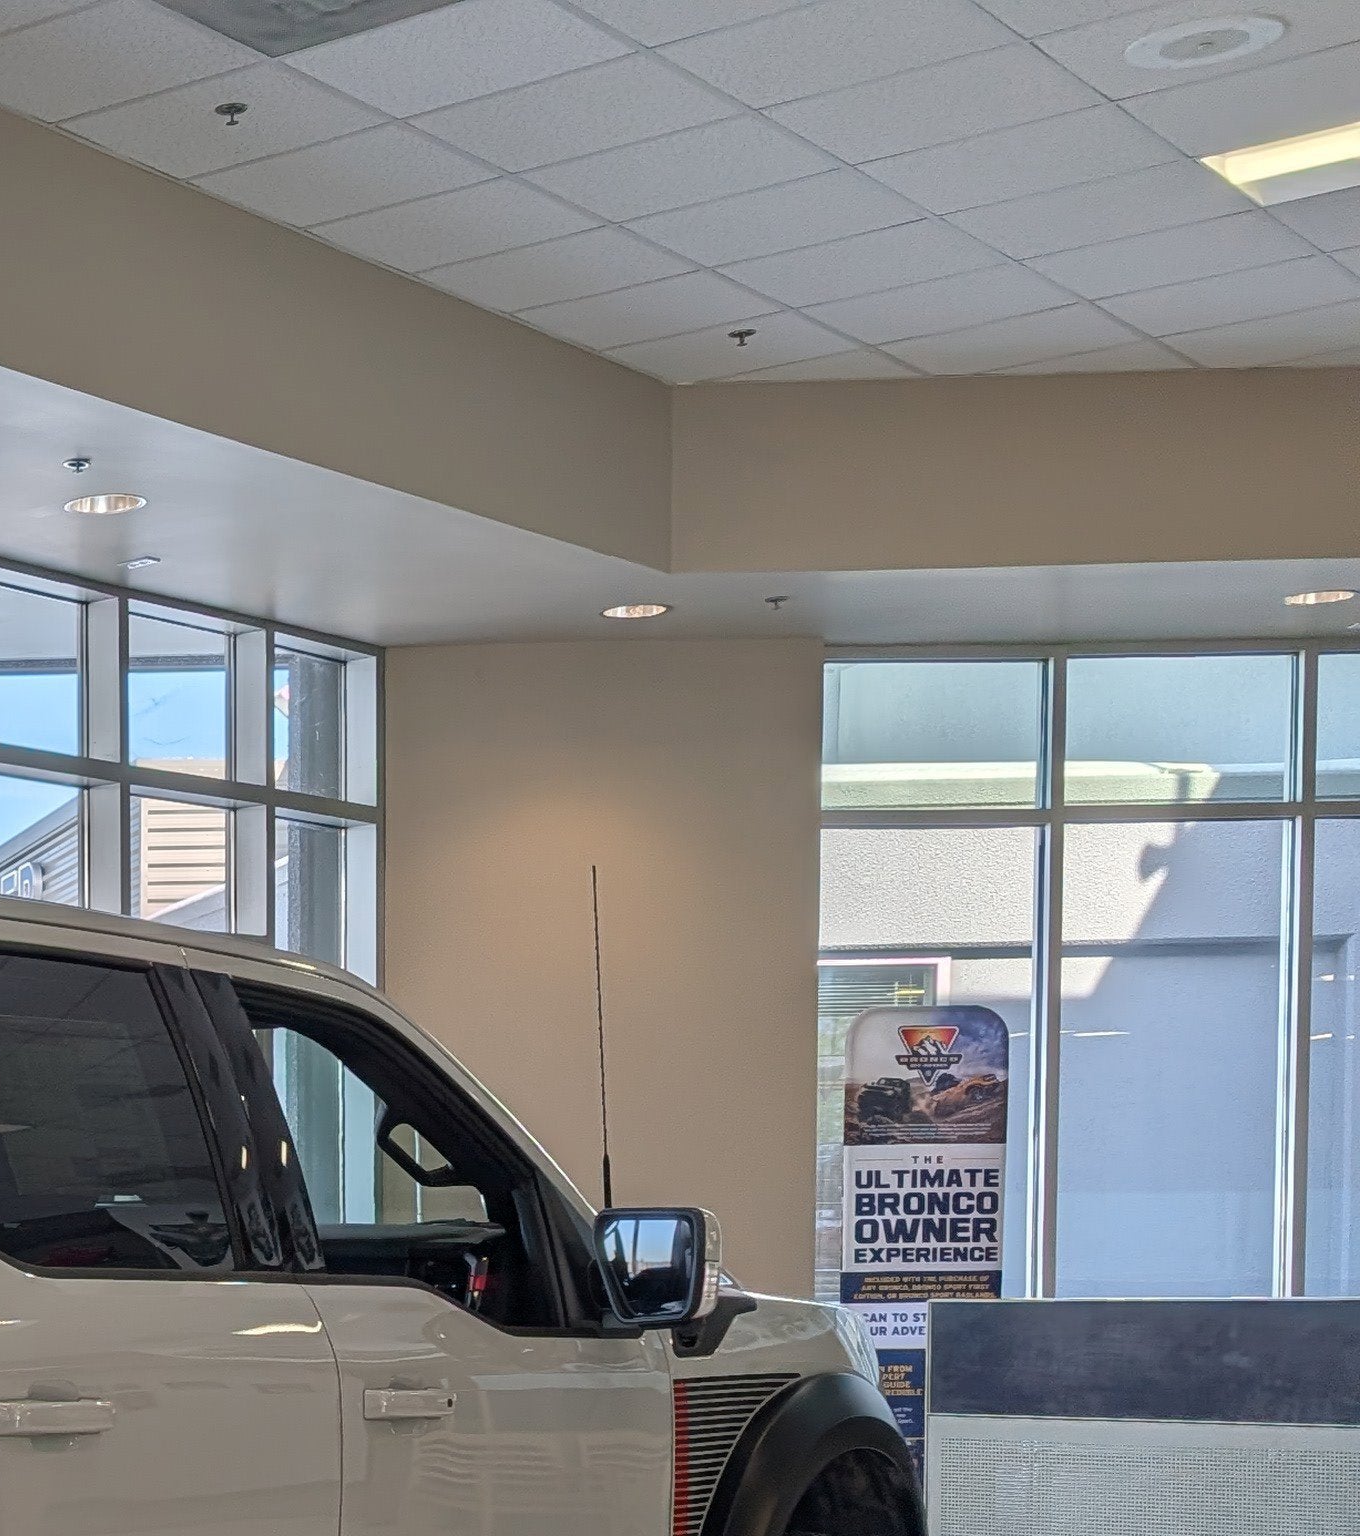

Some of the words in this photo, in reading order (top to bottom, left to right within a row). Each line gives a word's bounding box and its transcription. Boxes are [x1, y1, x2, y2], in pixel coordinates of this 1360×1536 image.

[910, 1155, 944, 1165] THE
[854, 1168, 1000, 1189] ULTIMATE
[854, 1191, 999, 1217] BRONCO
[854, 1217, 999, 1245] OWNER
[854, 1246, 999, 1264] EXPERIENCE
[892, 1313, 908, 1322] TO
